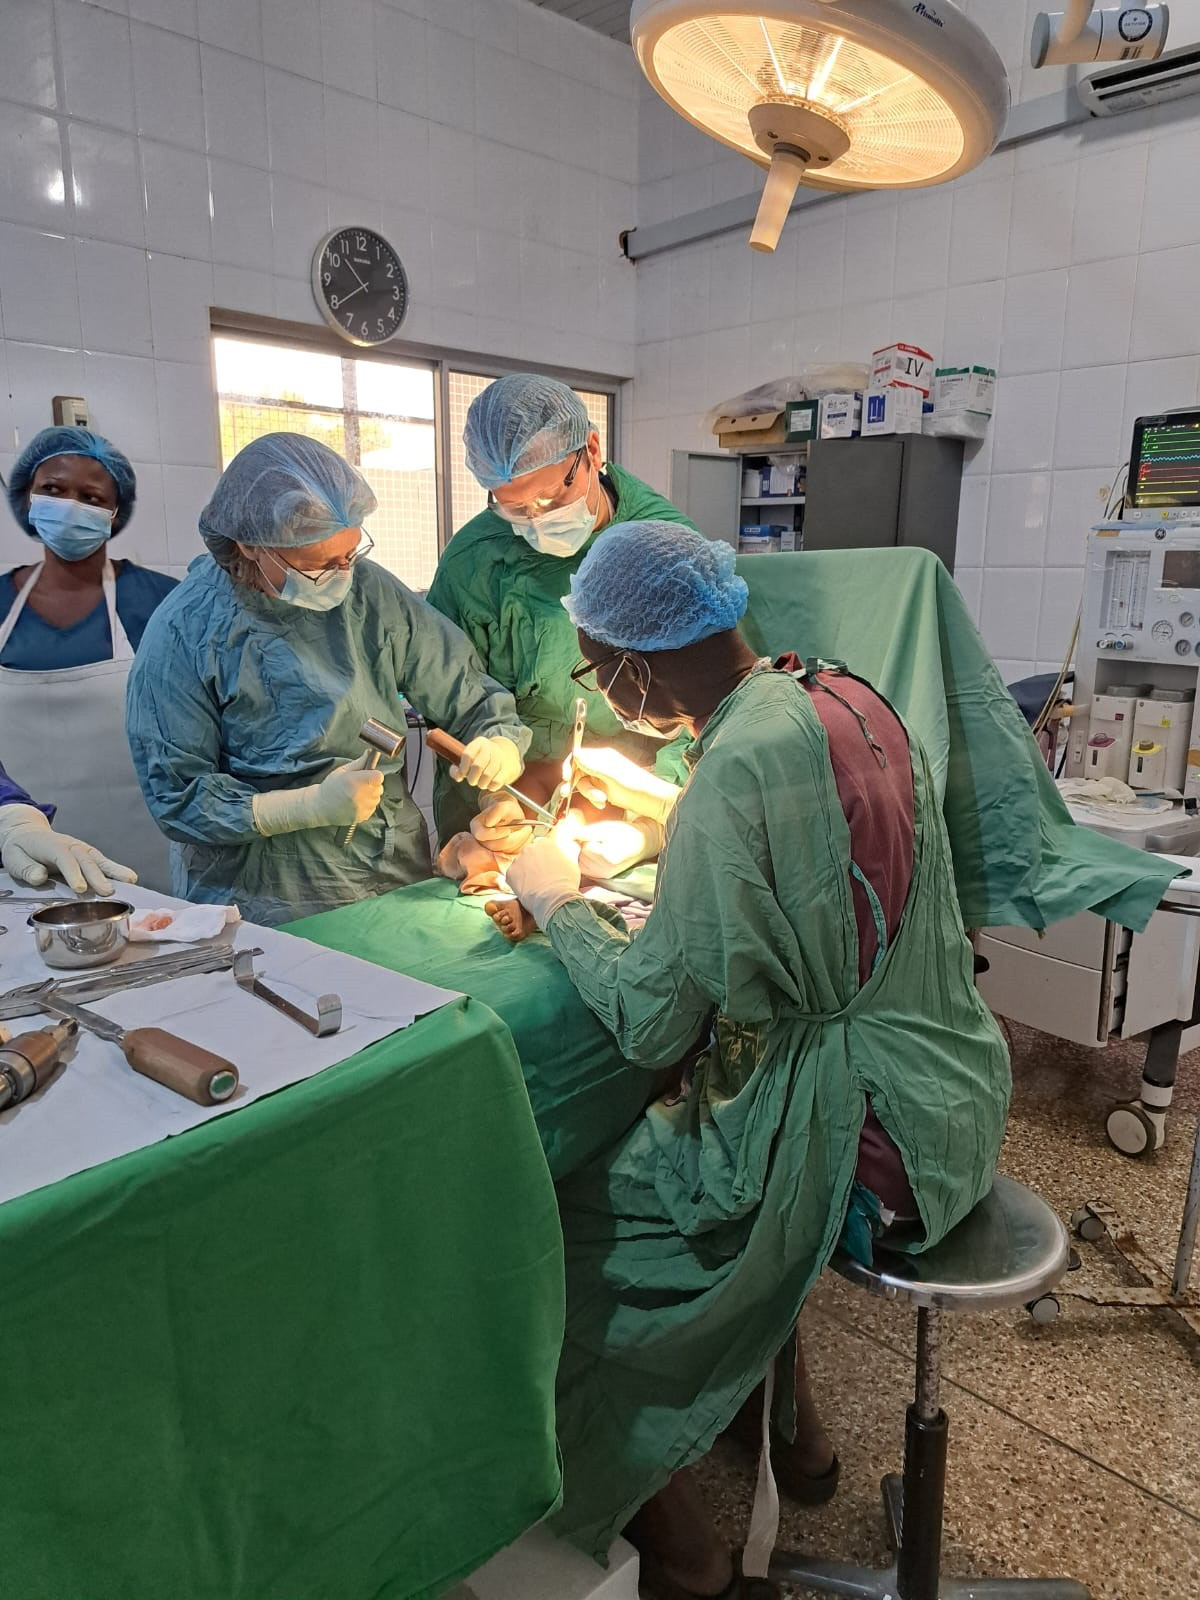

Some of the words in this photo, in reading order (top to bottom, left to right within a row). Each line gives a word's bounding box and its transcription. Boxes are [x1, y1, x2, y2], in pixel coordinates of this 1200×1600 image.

[340, 240, 349, 255] 11
[355, 236, 367, 252] 12
[329, 252, 340, 268] 10
[375, 246, 380, 261] 1
[386, 264, 394, 278] 2
[324, 272, 332, 286] 9
[392, 286, 400, 300] 3
[331, 295, 339, 309] 8
[346, 312, 354, 327] 7
[388, 307, 395, 321] 4
[361, 321, 369, 336] 6
[377, 319, 384, 333] 5
[905, 357, 924, 377] IV
